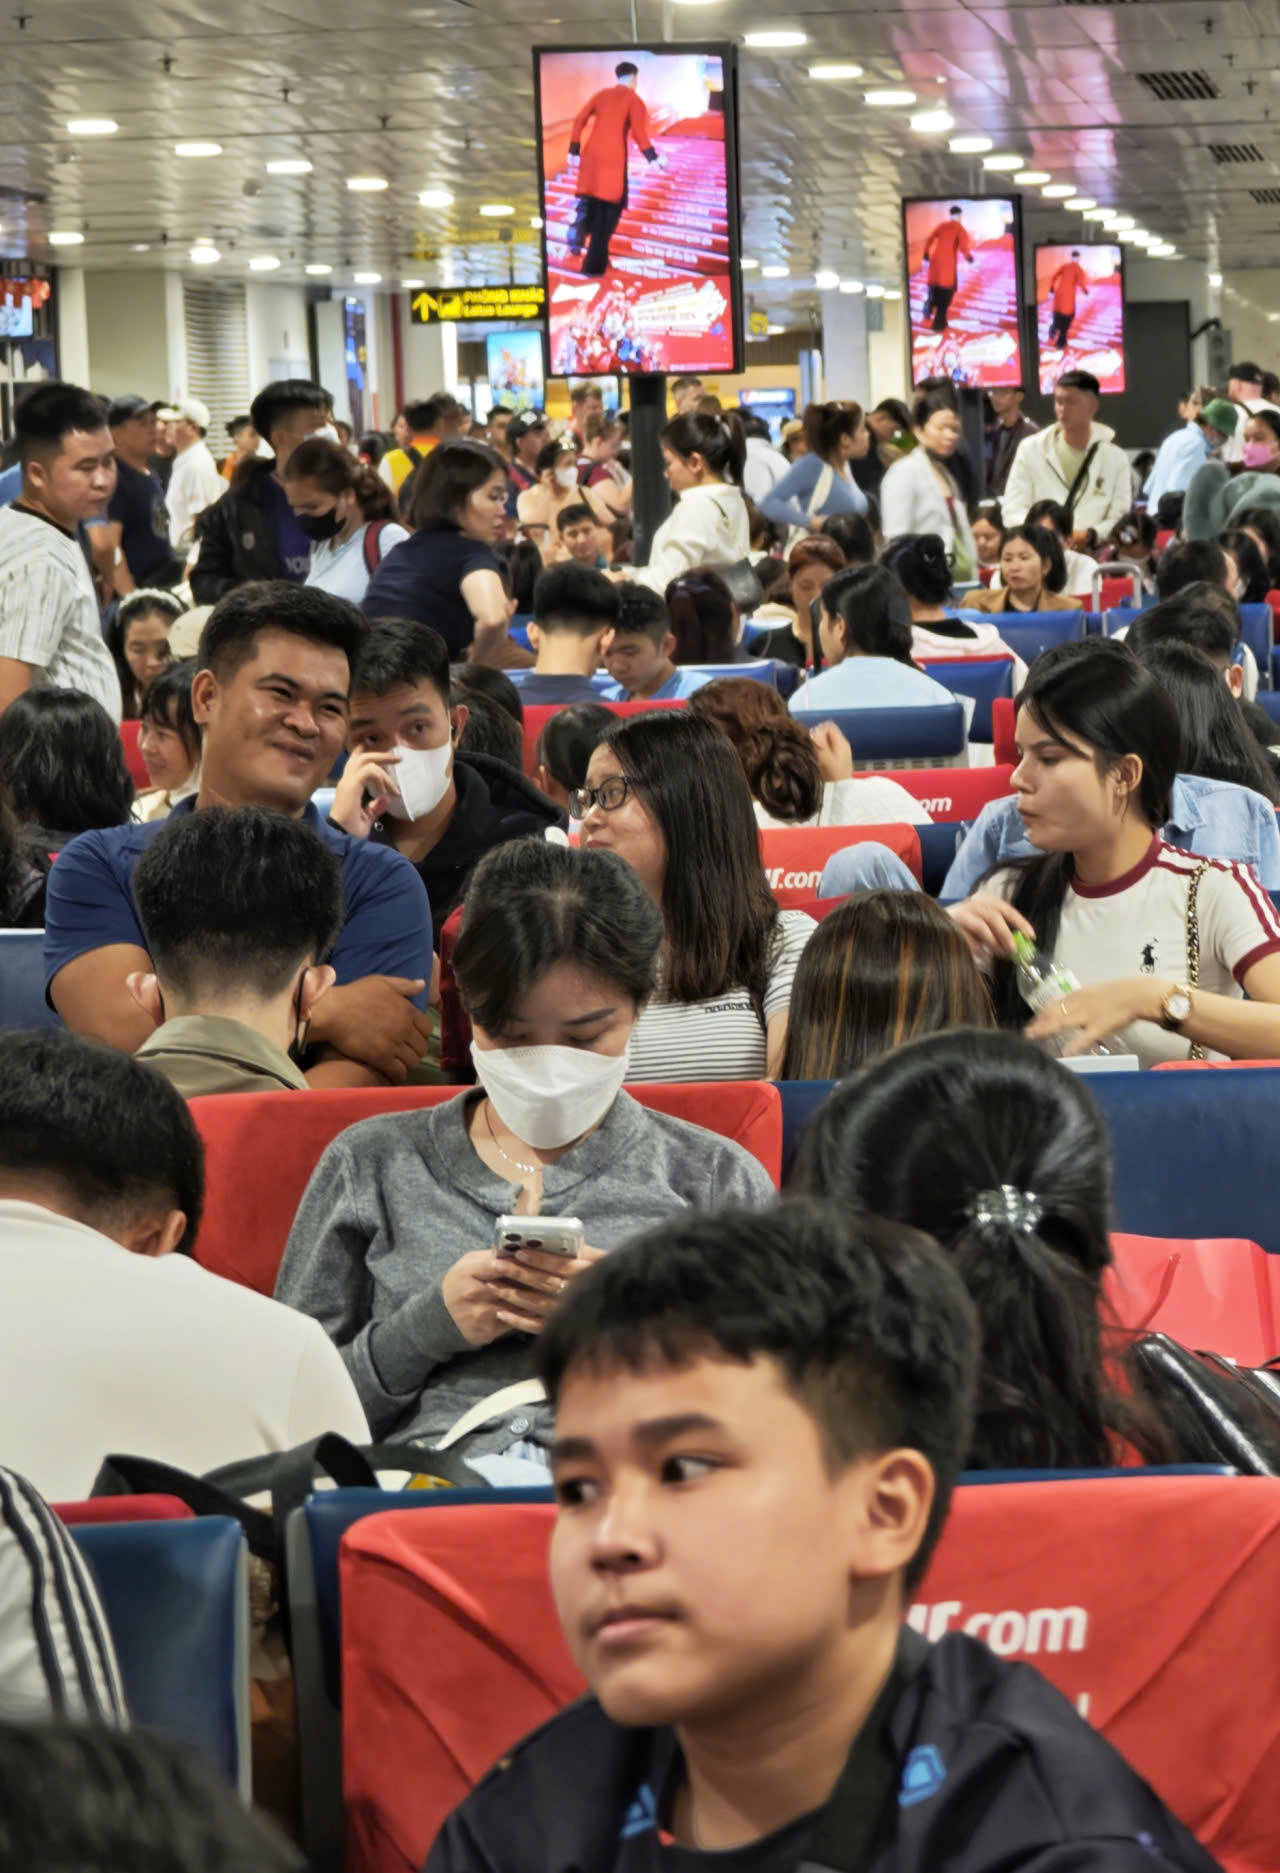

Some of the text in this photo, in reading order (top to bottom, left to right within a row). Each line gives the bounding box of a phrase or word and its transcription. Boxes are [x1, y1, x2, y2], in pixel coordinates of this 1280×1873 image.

[510, 286, 545, 303] KHÁC
[463, 303, 539, 318] Lotus Lounge
